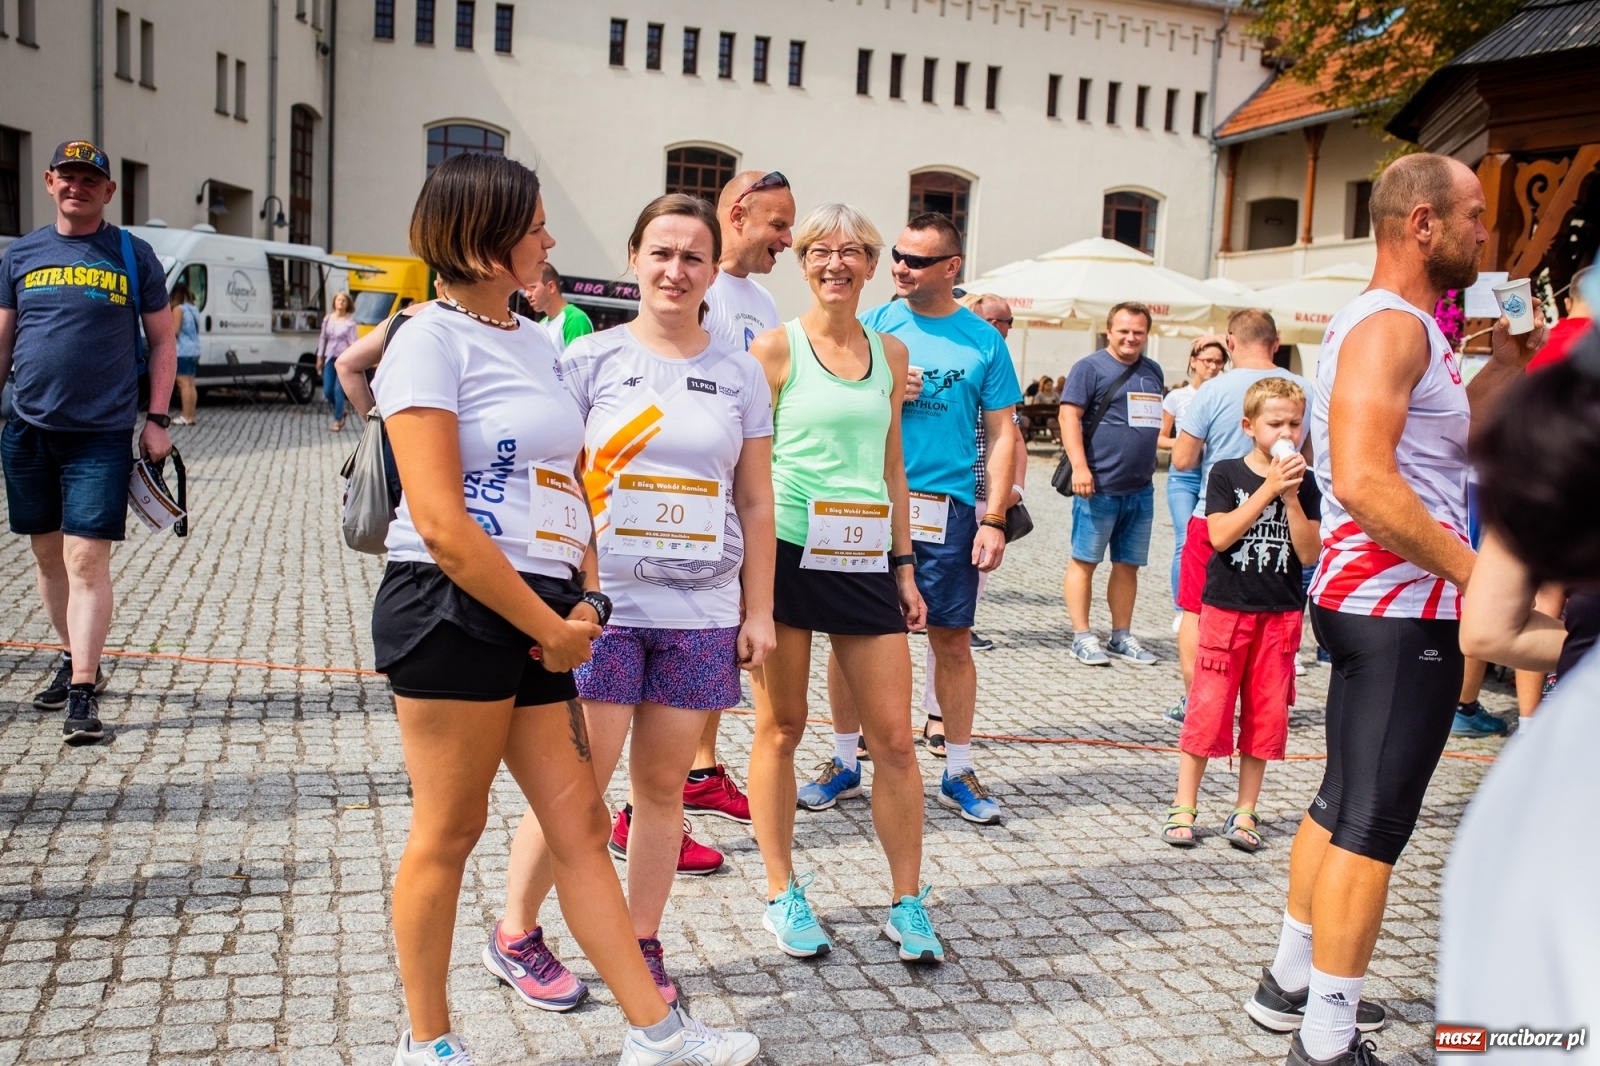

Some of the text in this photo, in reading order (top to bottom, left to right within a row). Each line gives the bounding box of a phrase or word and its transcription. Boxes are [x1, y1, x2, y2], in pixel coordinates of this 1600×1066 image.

[573, 282, 605, 295] BBQ
[110, 292, 127, 305] 2019
[903, 400, 948, 412] IATHLON
[637, 481, 654, 489] Bieg
[656, 482, 680, 490] Wokół
[681, 485, 708, 493] Komina
[564, 505, 577, 530] 13
[655, 503, 685, 524] 20
[829, 507, 842, 515] Bieg
[843, 525, 863, 544] 19
